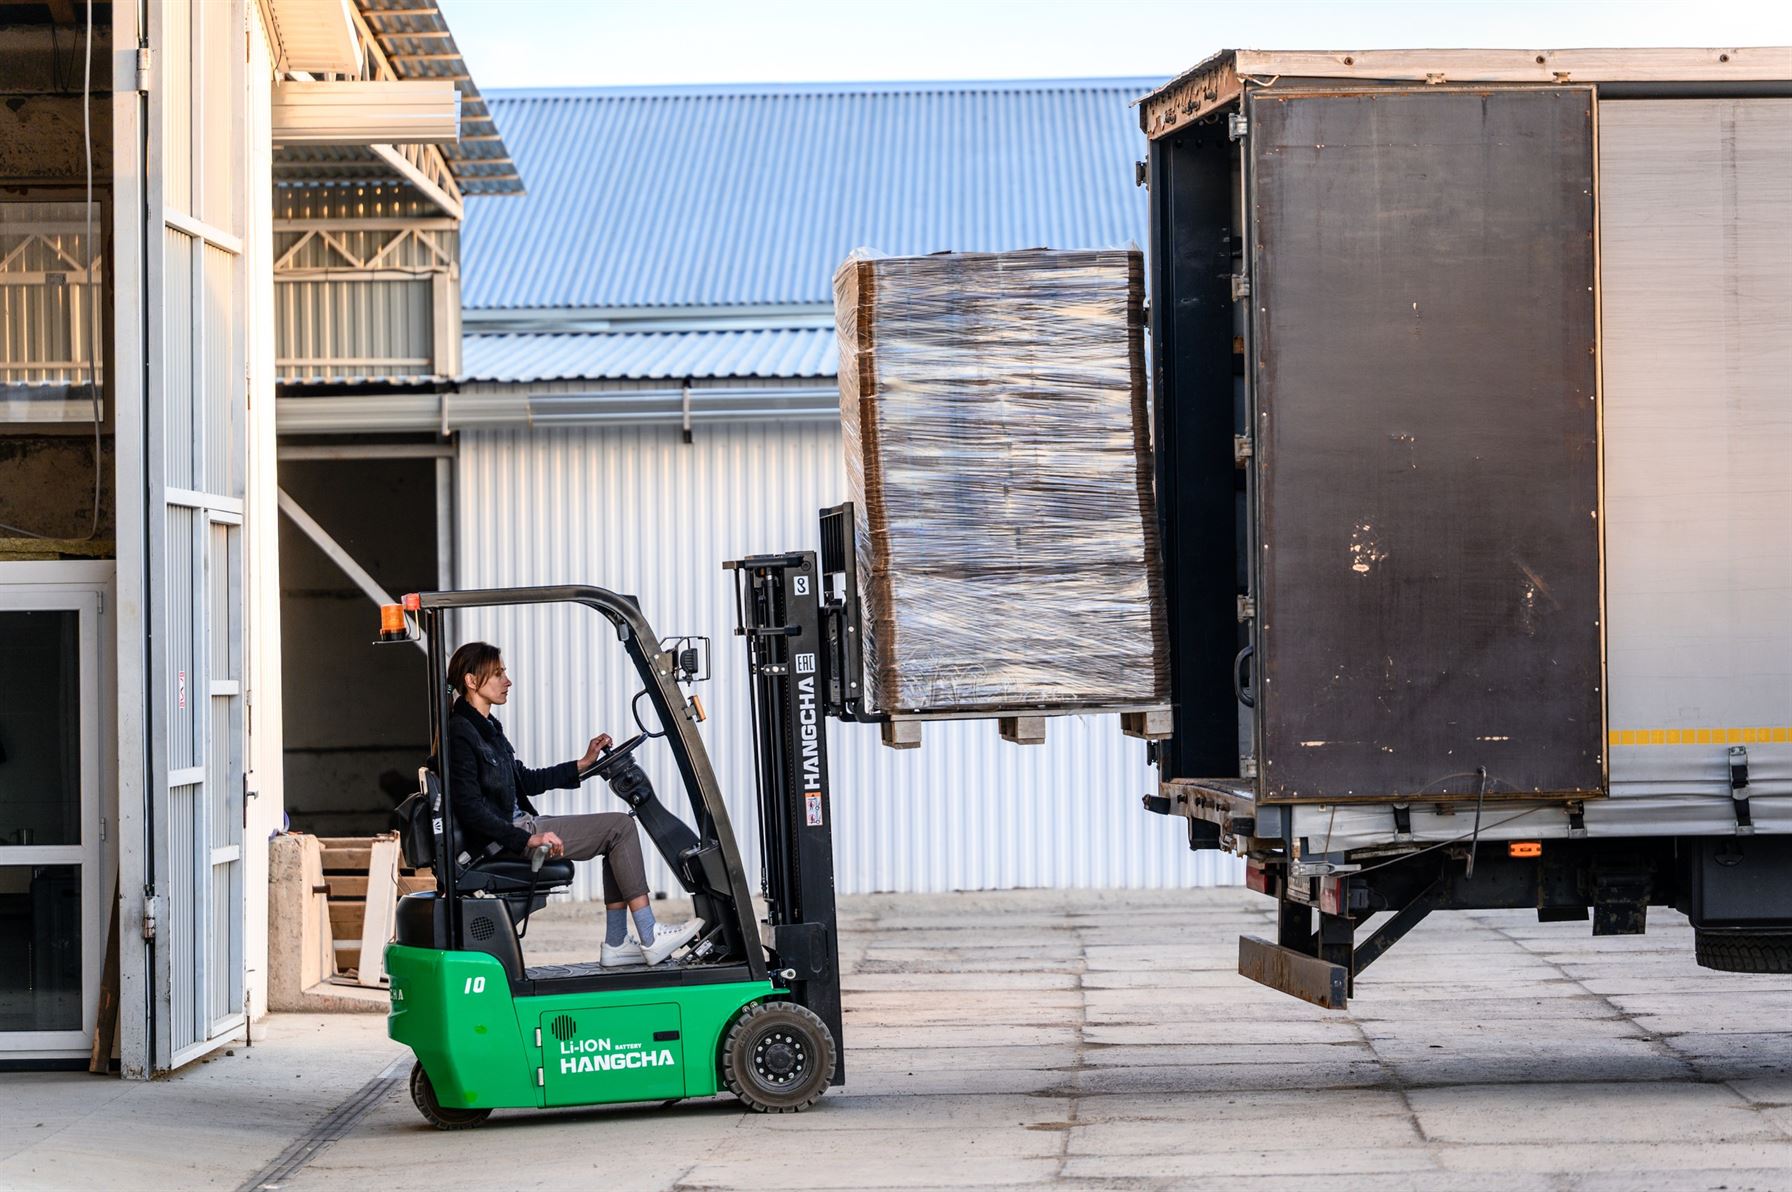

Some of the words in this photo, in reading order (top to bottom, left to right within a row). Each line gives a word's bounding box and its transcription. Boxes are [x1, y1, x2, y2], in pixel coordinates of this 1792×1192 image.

[797, 654, 815, 672] EAC
[798, 676, 820, 790] HANGCHA
[464, 976, 486, 994] 10
[560, 1038, 611, 1054] Li-ION
[560, 1049, 675, 1074] HANGCHA
